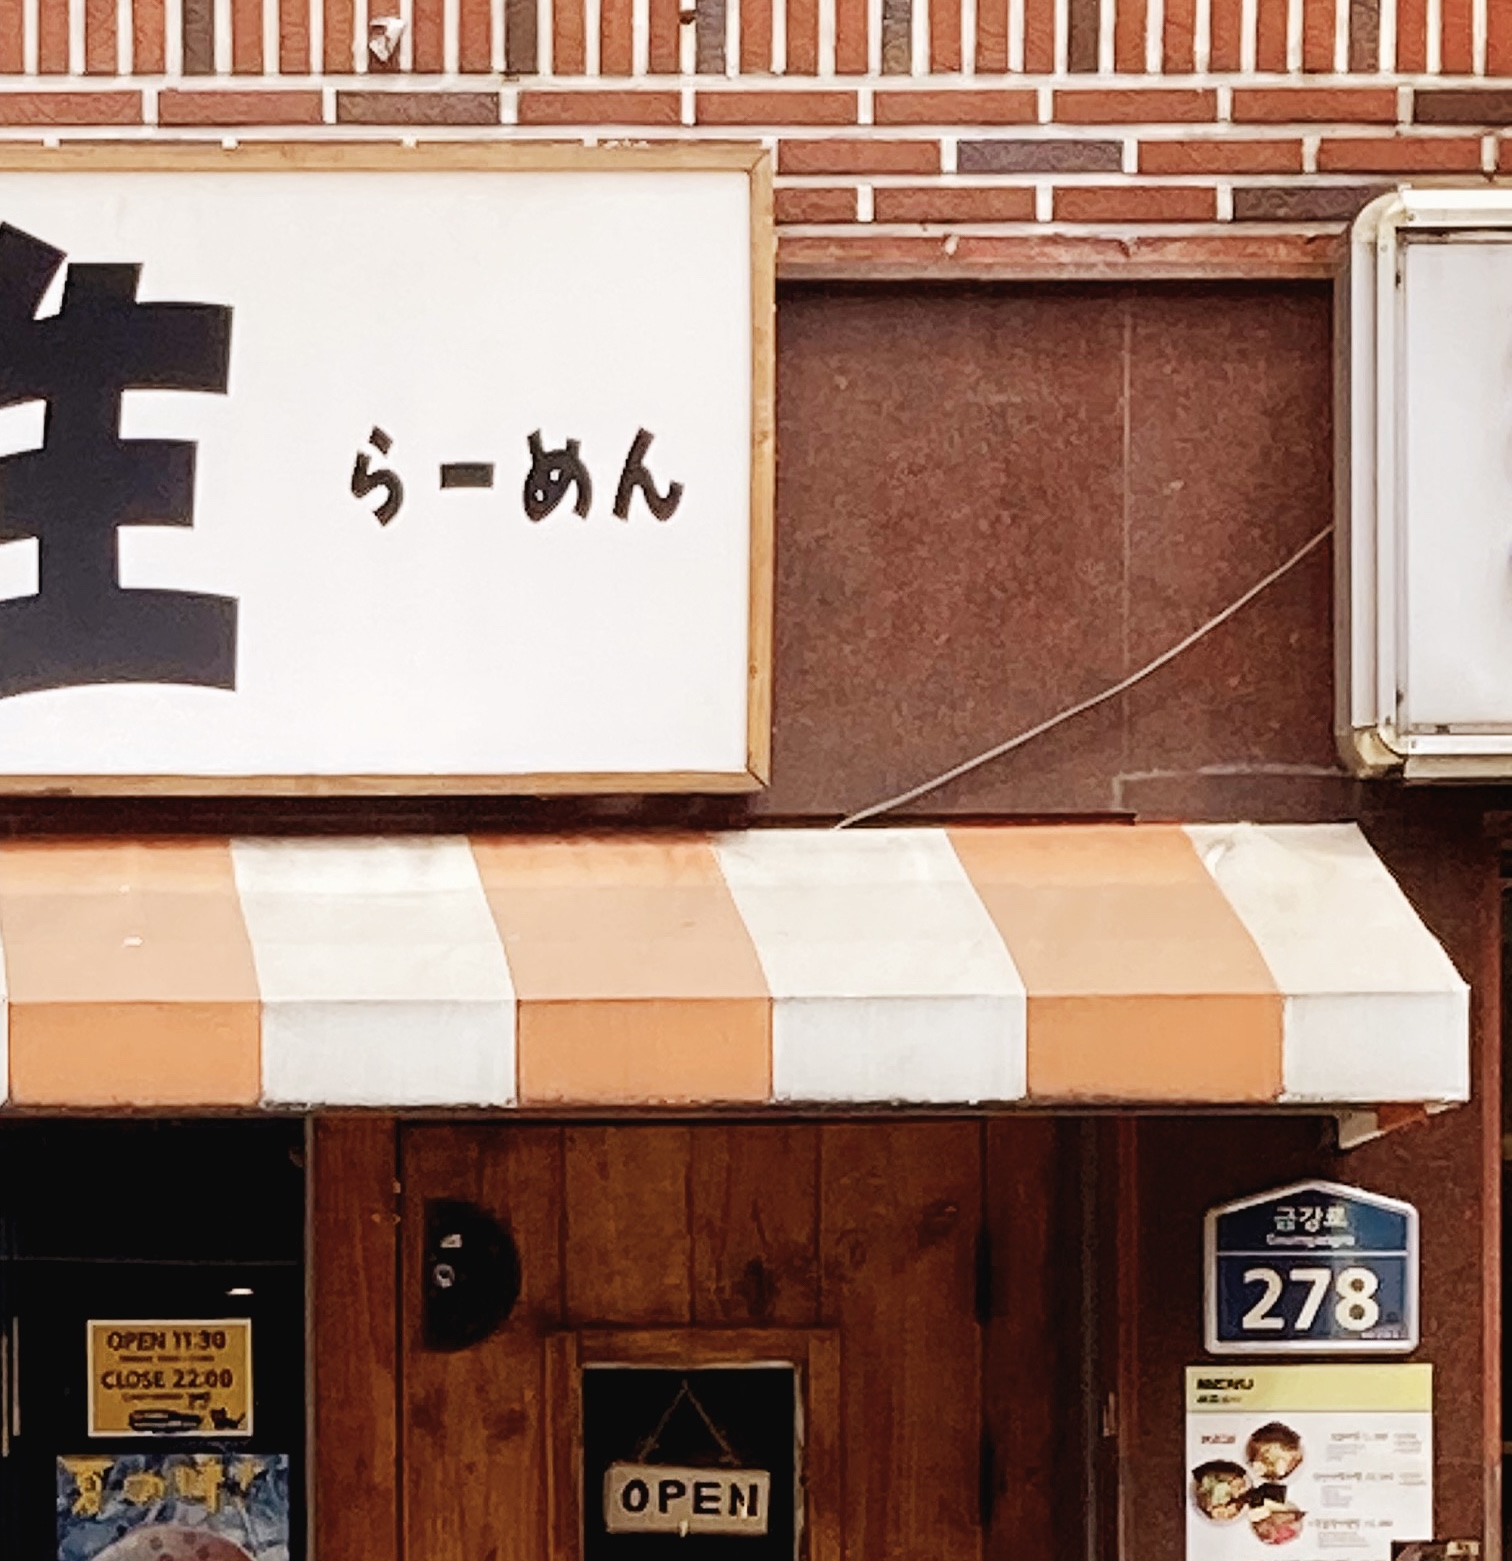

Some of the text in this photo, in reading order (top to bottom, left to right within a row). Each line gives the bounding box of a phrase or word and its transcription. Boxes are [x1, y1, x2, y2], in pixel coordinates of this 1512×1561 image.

[352, 428, 682, 525] らーめん
[1273, 1205, 1349, 1232] 금강로
[1242, 1266, 1380, 1332] 278
[106, 1330, 227, 1351] OPEN 11:30
[100, 1369, 234, 1389] CLOSE 22:00
[622, 1479, 758, 1517] OPEN
